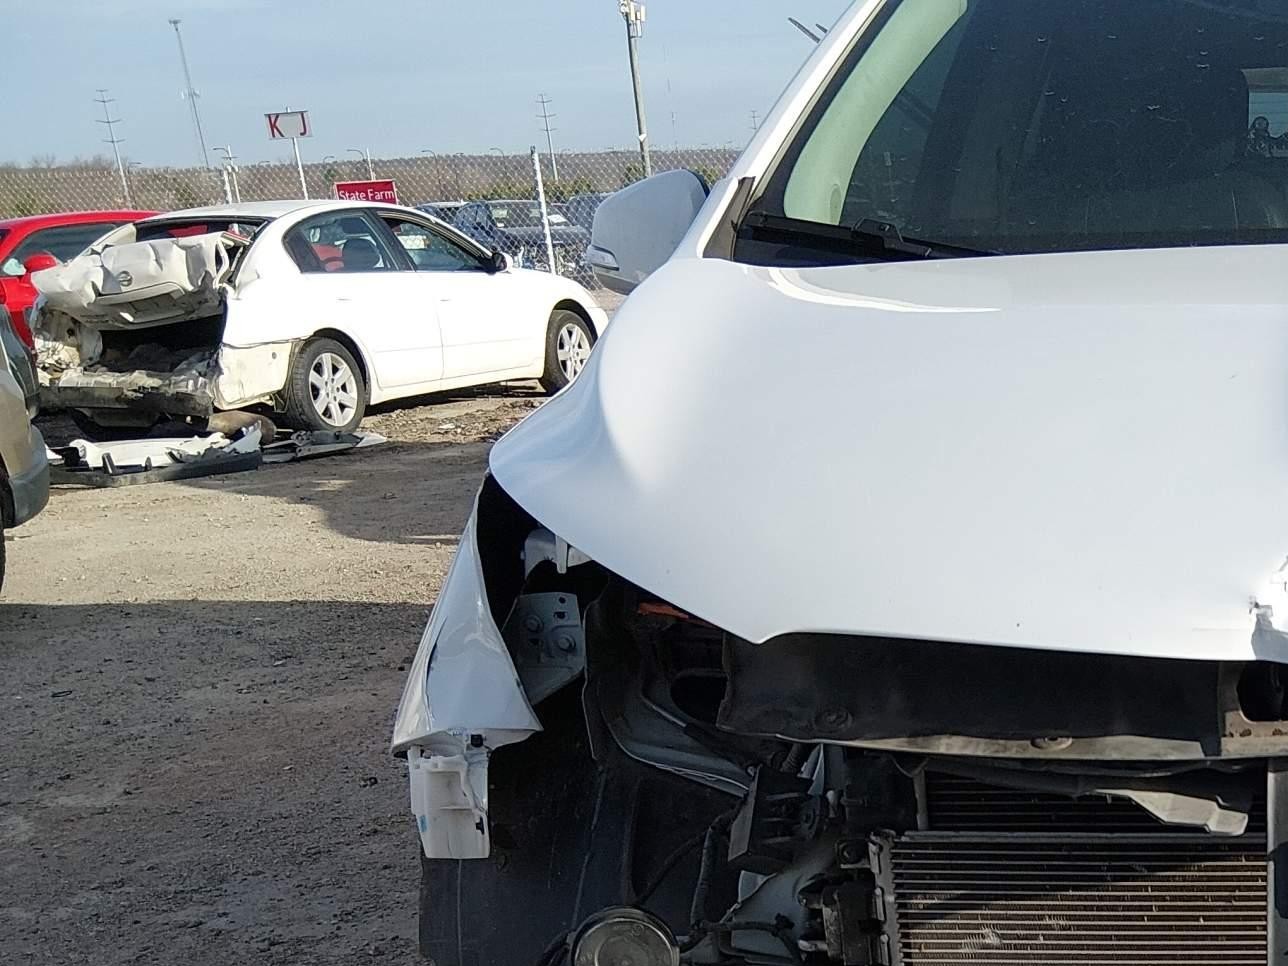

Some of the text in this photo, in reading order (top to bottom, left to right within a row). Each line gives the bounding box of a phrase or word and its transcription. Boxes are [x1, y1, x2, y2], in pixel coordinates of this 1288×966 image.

[268, 113, 307, 138] K J
[339, 188, 394, 201] State Farm
